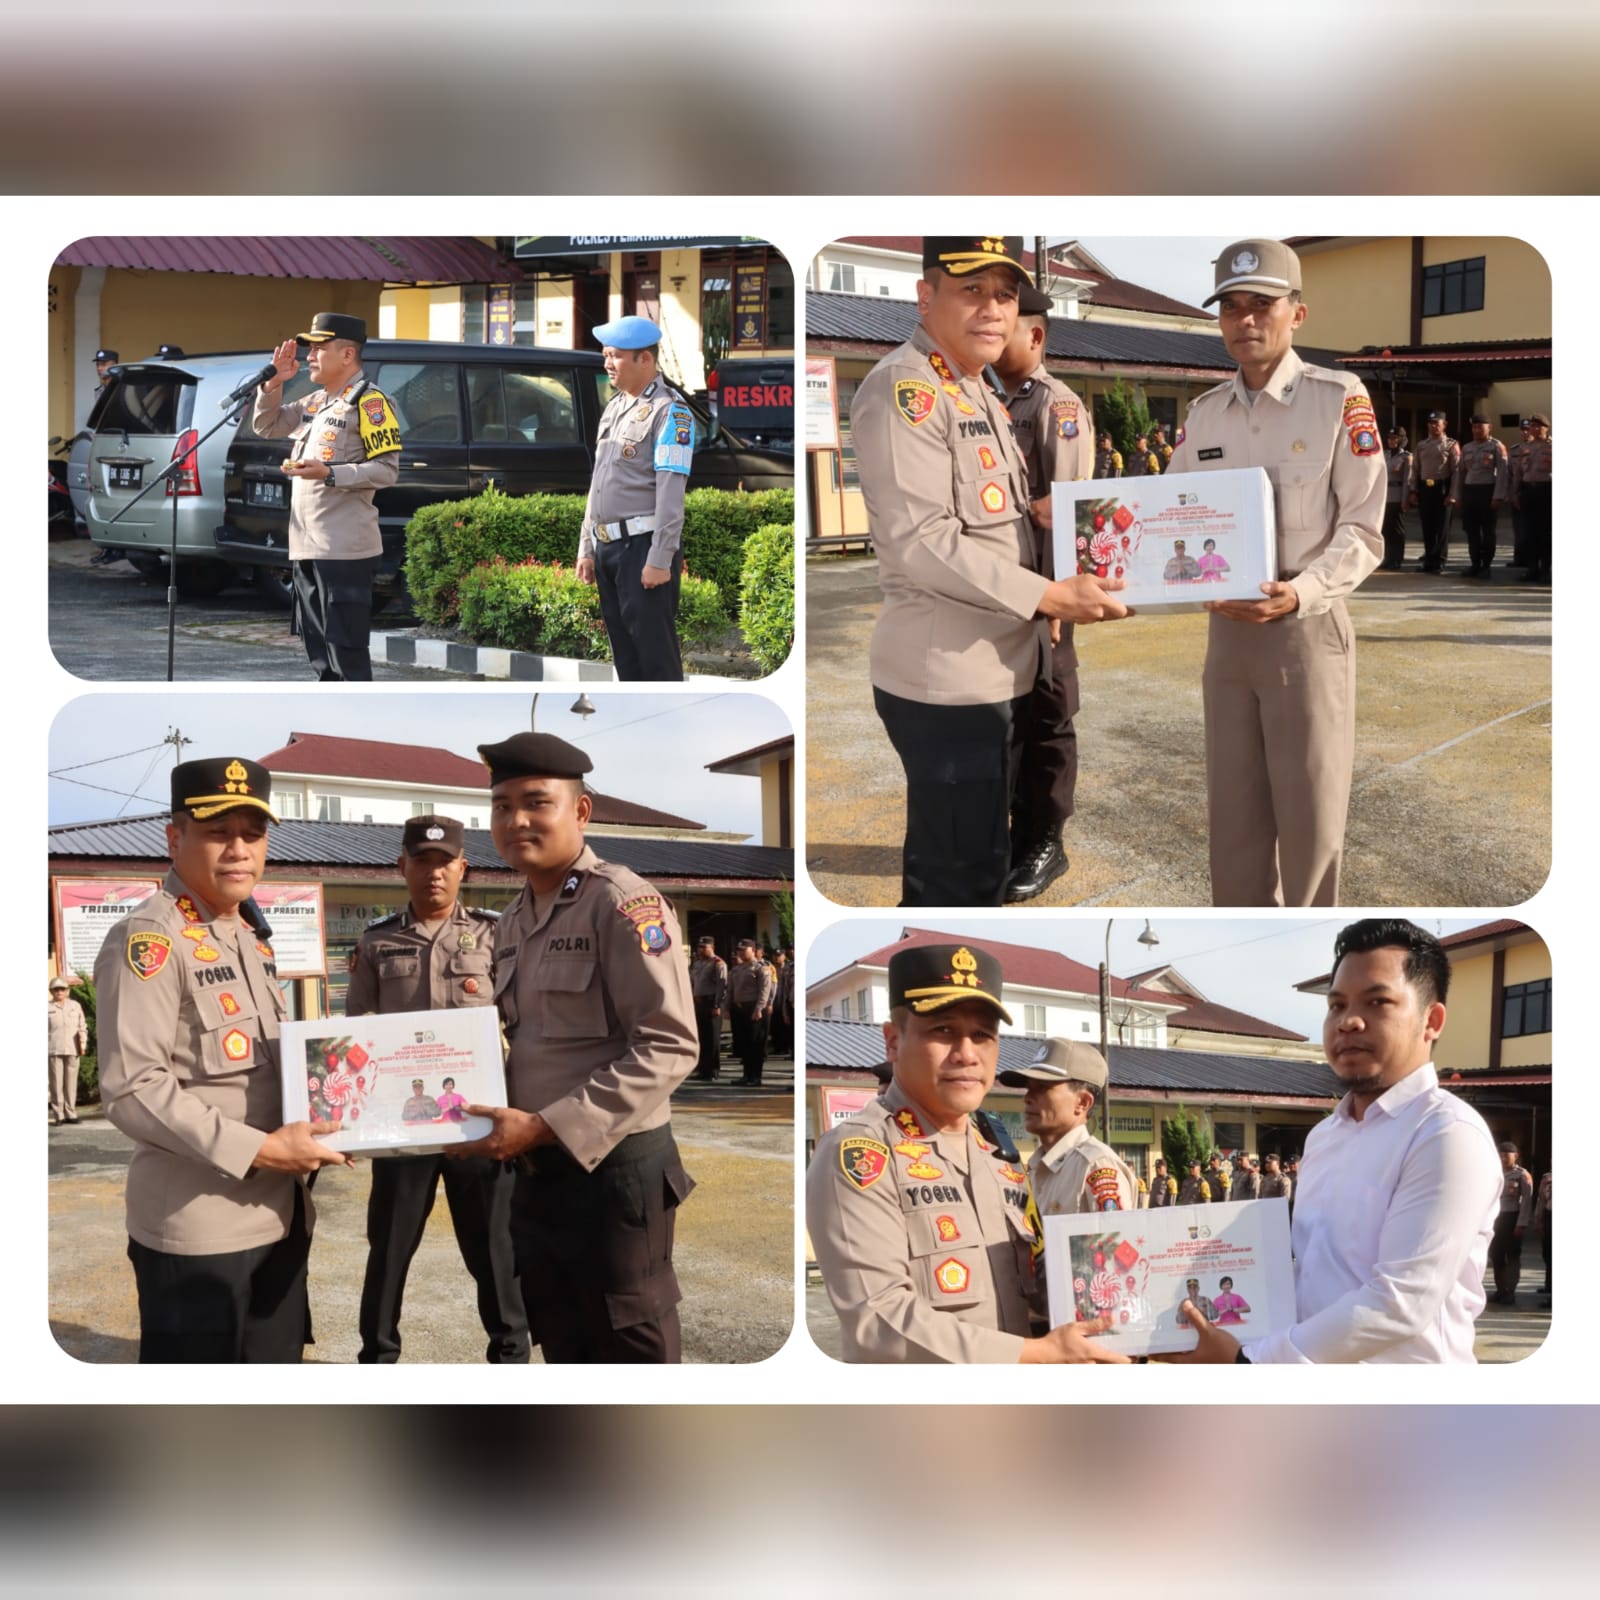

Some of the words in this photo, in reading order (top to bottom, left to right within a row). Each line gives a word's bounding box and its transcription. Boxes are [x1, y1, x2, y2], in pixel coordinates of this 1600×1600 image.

[724, 385, 793, 407] RESKR
[370, 428, 391, 450] OPS
[273, 907, 316, 915] PRASETYA
[550, 936, 590, 952] POLRI
[194, 965, 237, 987] YOGEN
[906, 1185, 963, 1207] YOGEN
